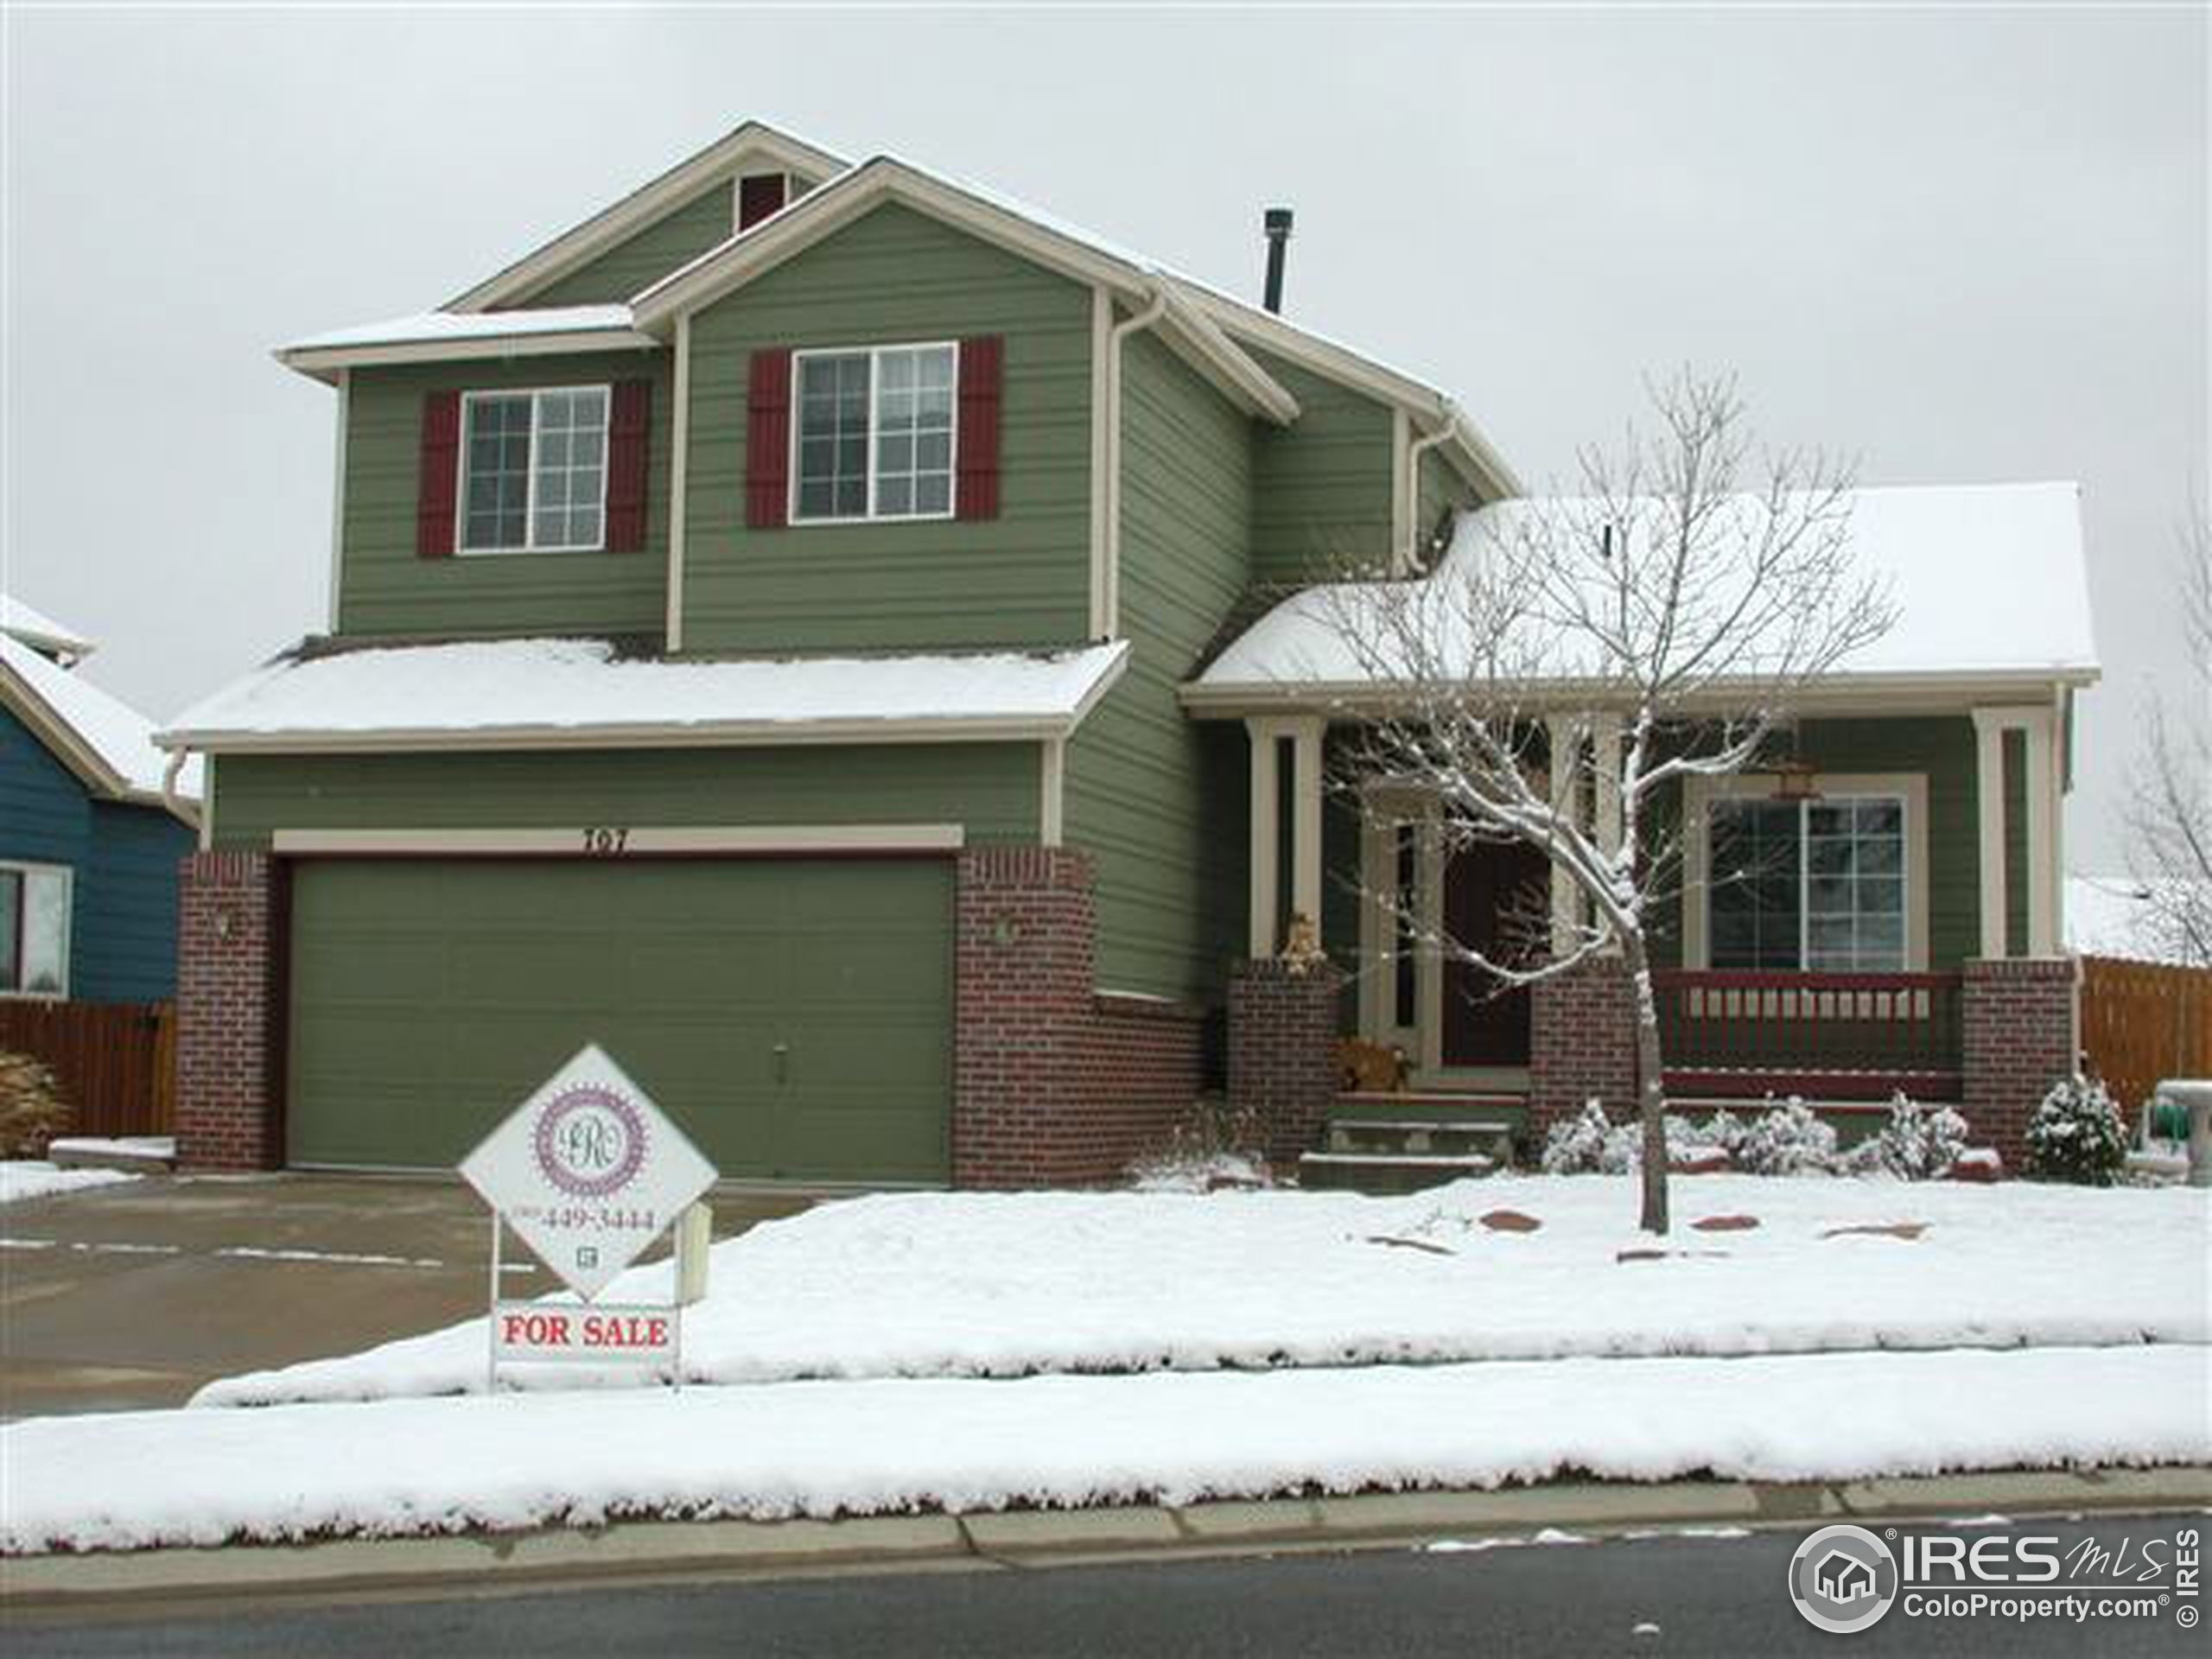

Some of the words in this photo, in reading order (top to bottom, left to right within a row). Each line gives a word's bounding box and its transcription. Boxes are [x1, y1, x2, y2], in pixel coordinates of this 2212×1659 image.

[583, 829, 629, 851] 707
[502, 1315, 570, 1345] FOR
[582, 1317, 669, 1346] SALE
